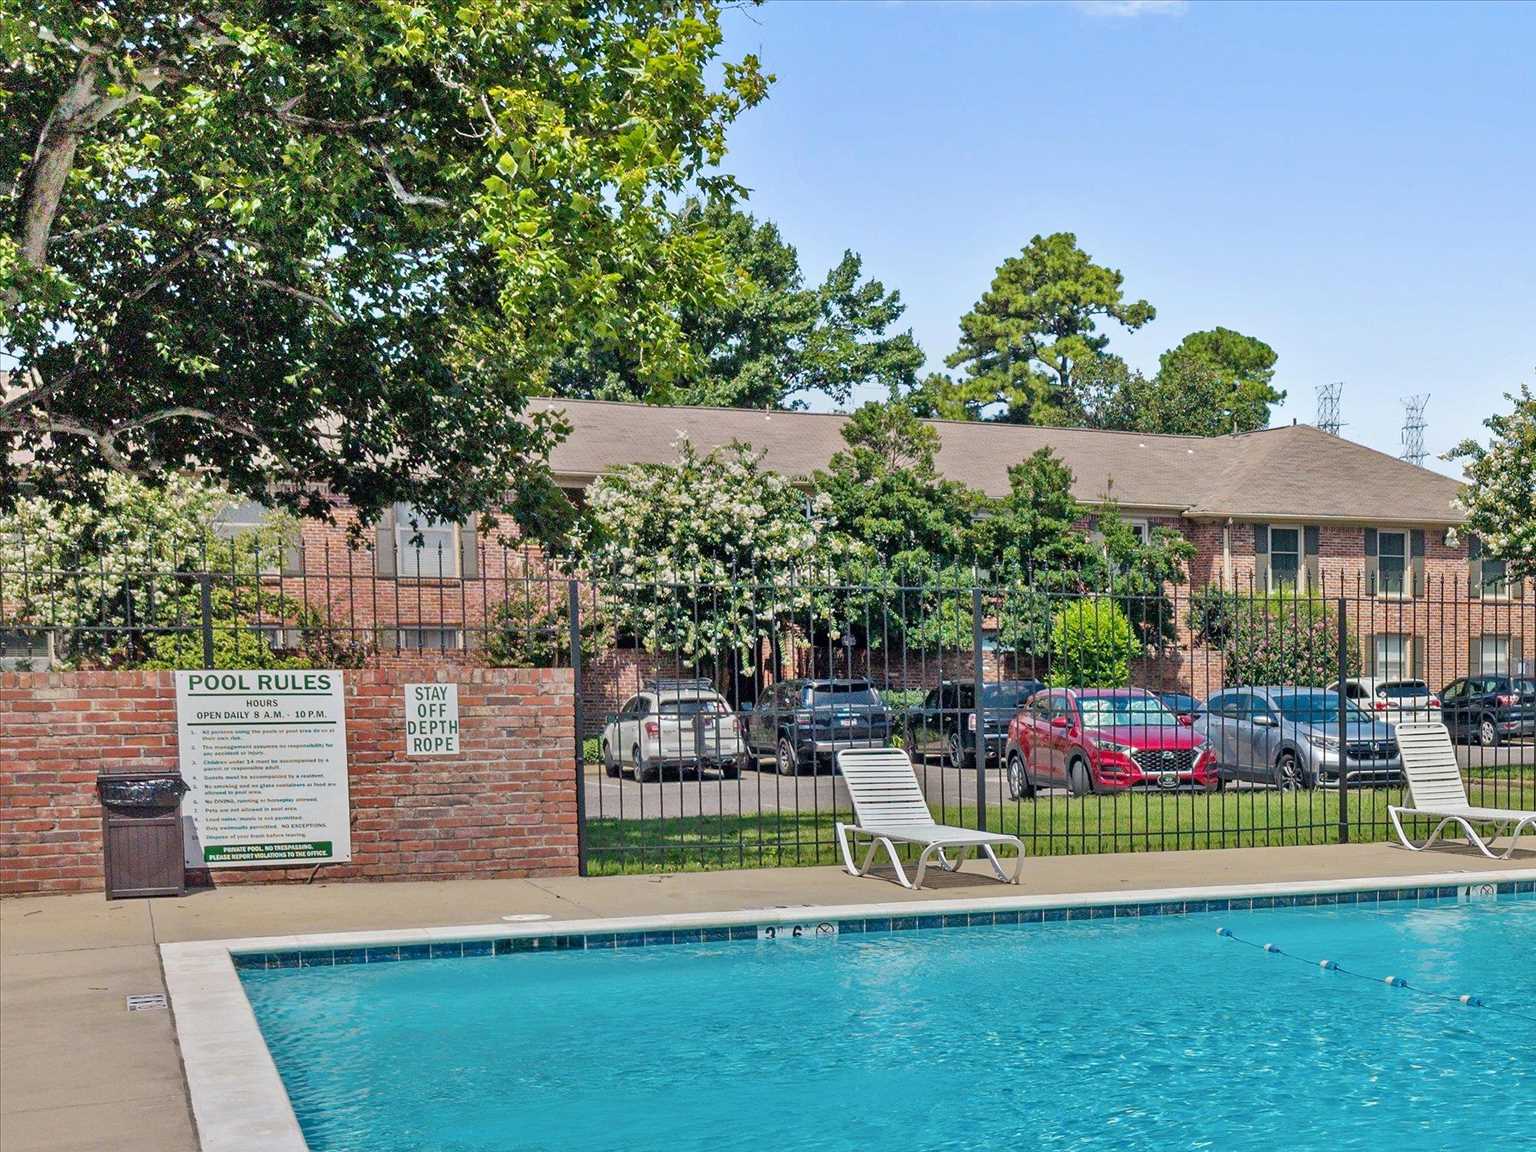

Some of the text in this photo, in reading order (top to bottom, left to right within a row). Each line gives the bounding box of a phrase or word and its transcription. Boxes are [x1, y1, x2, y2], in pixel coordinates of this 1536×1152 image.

[189, 674, 331, 690] POOL RULES
[415, 686, 448, 700] STAY
[246, 699, 278, 708] HOURS
[224, 711, 249, 719] DAILY
[264, 711, 284, 719] A.M.
[295, 710, 306, 718] 10
[308, 710, 327, 718] P.M.
[418, 704, 446, 718] OFF
[408, 720, 457, 734] DEPTH
[414, 737, 454, 752] ROPE
[765, 926, 776, 939] 3
